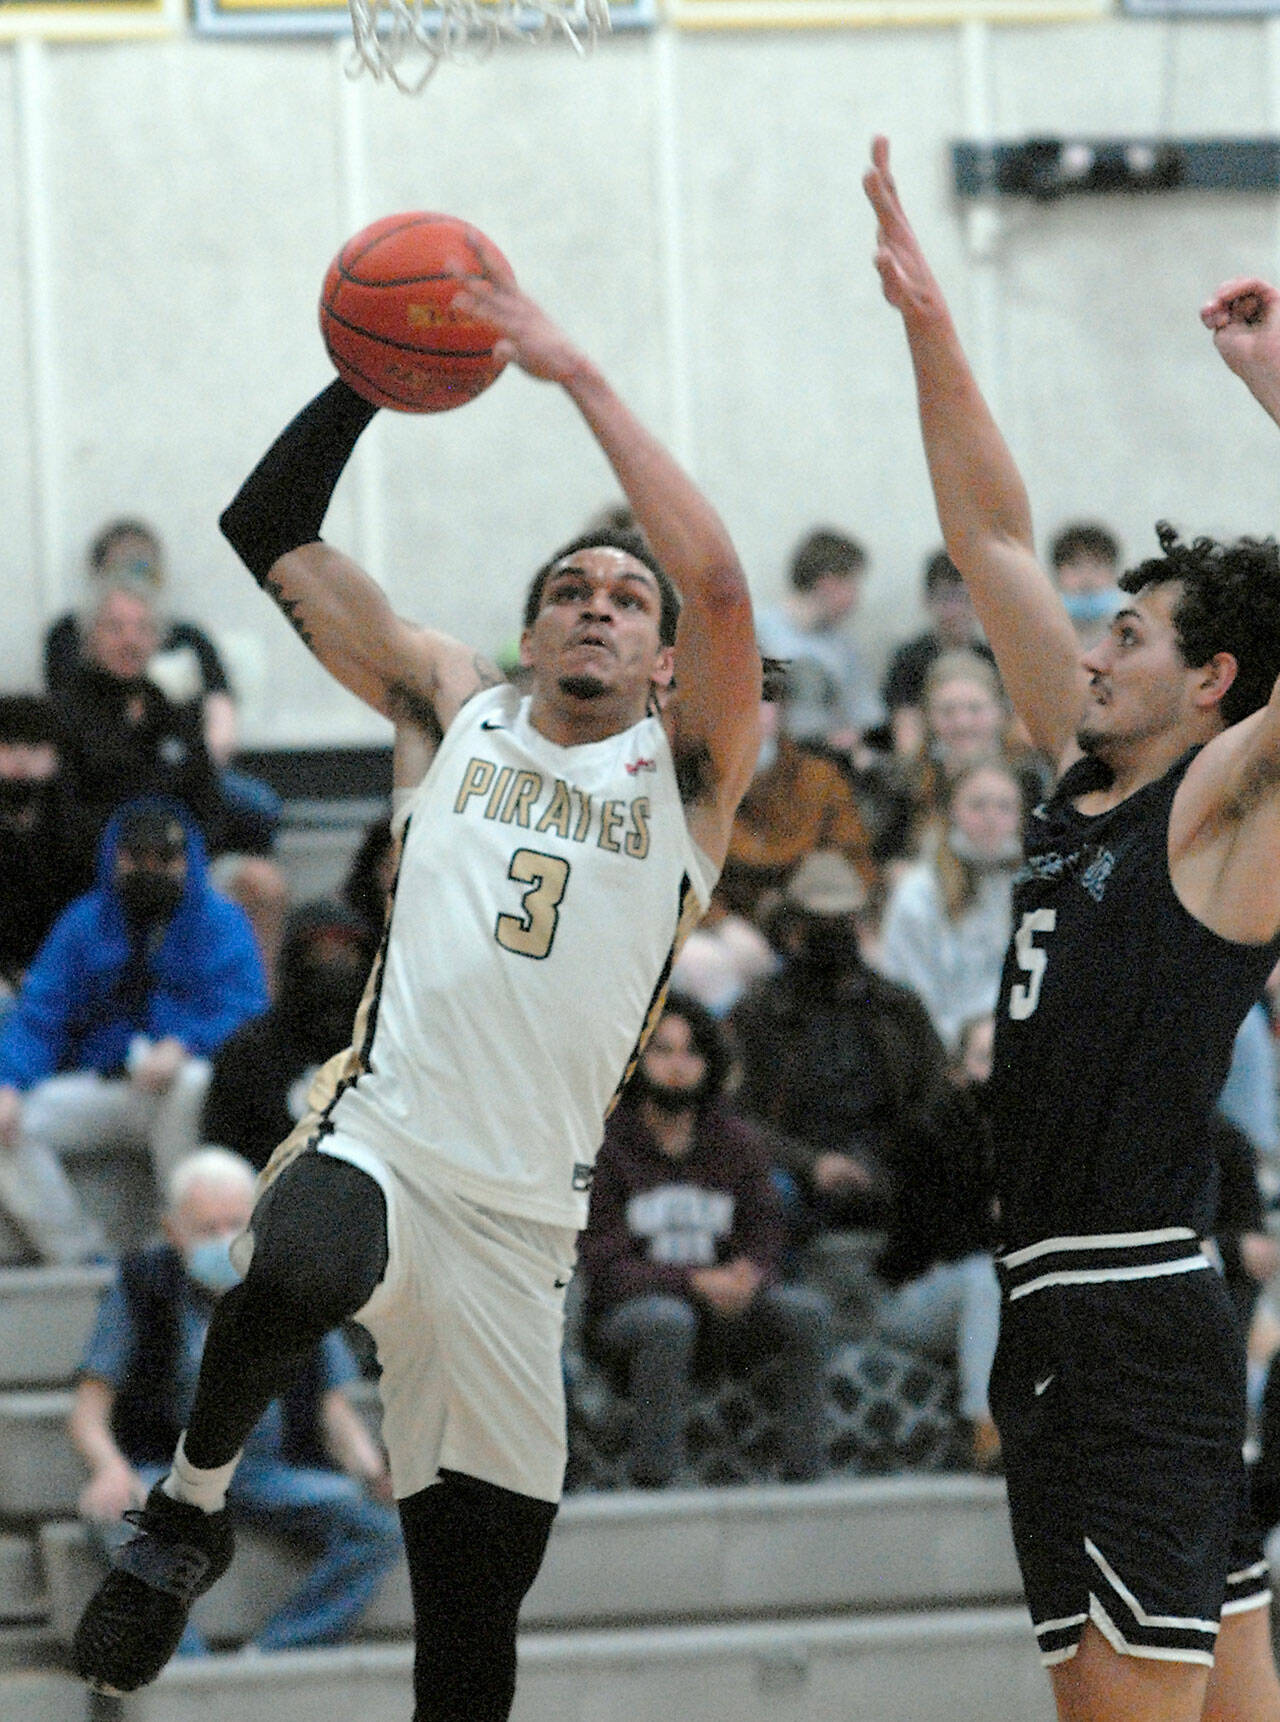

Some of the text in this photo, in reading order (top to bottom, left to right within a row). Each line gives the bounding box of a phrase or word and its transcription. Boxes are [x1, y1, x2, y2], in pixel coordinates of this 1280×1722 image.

[453, 757, 651, 860] PIRATES
[494, 847, 571, 960] 3
[1009, 908, 1057, 1020] 5
